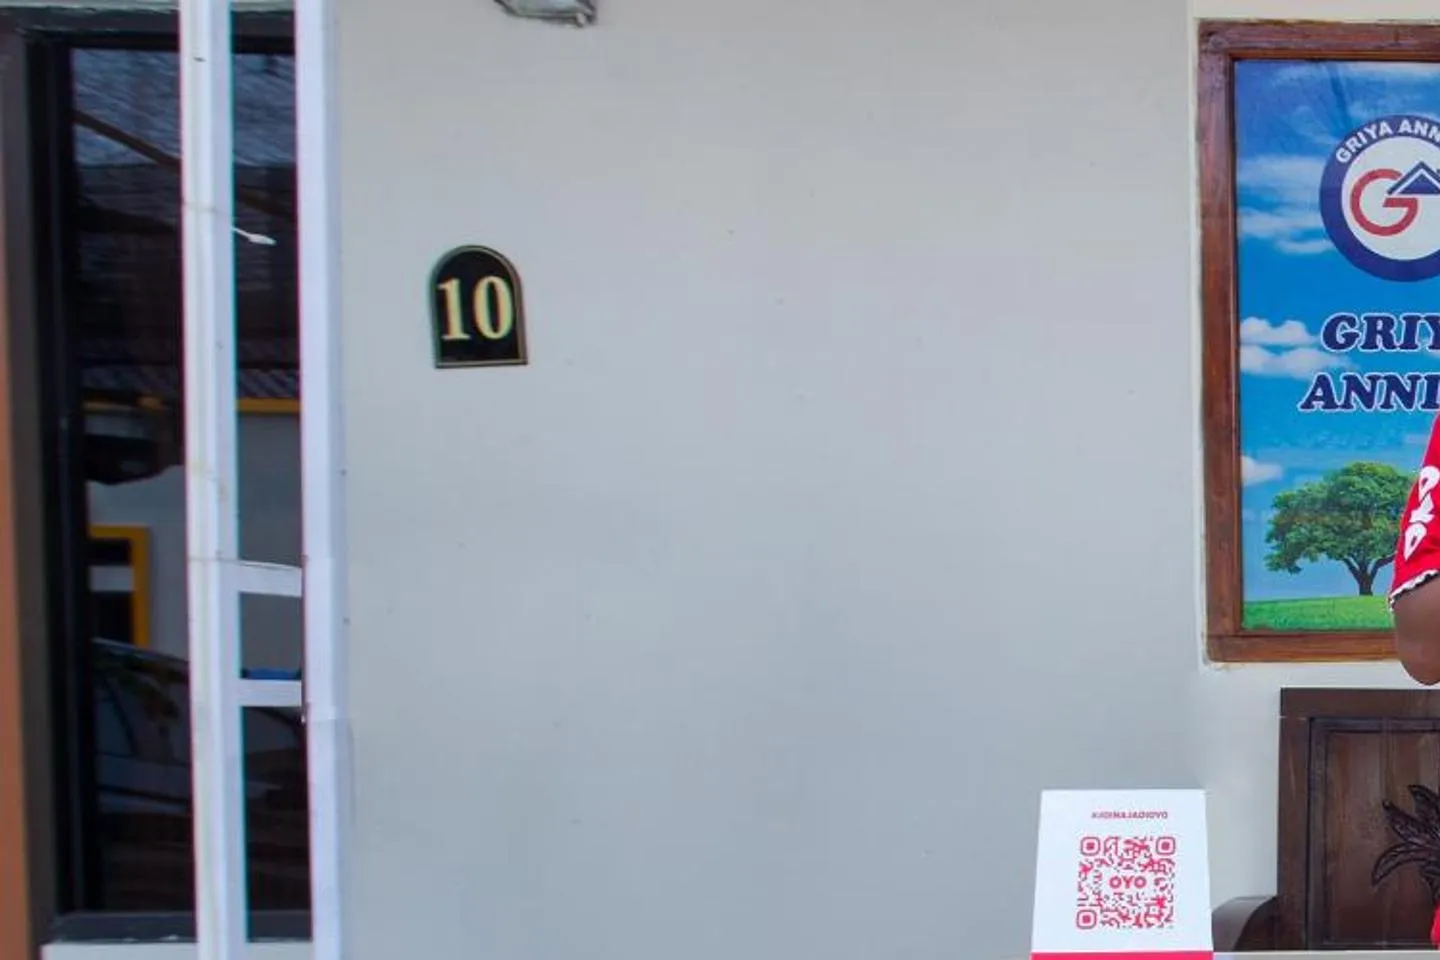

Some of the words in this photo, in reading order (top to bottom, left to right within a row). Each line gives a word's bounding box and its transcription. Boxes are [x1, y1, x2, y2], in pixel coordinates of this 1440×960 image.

[1335, 121, 1393, 163] GRIYA
[437, 275, 513, 340] 10
[1403, 466, 1440, 561] OYO
[1109, 876, 1147, 889] OYO
